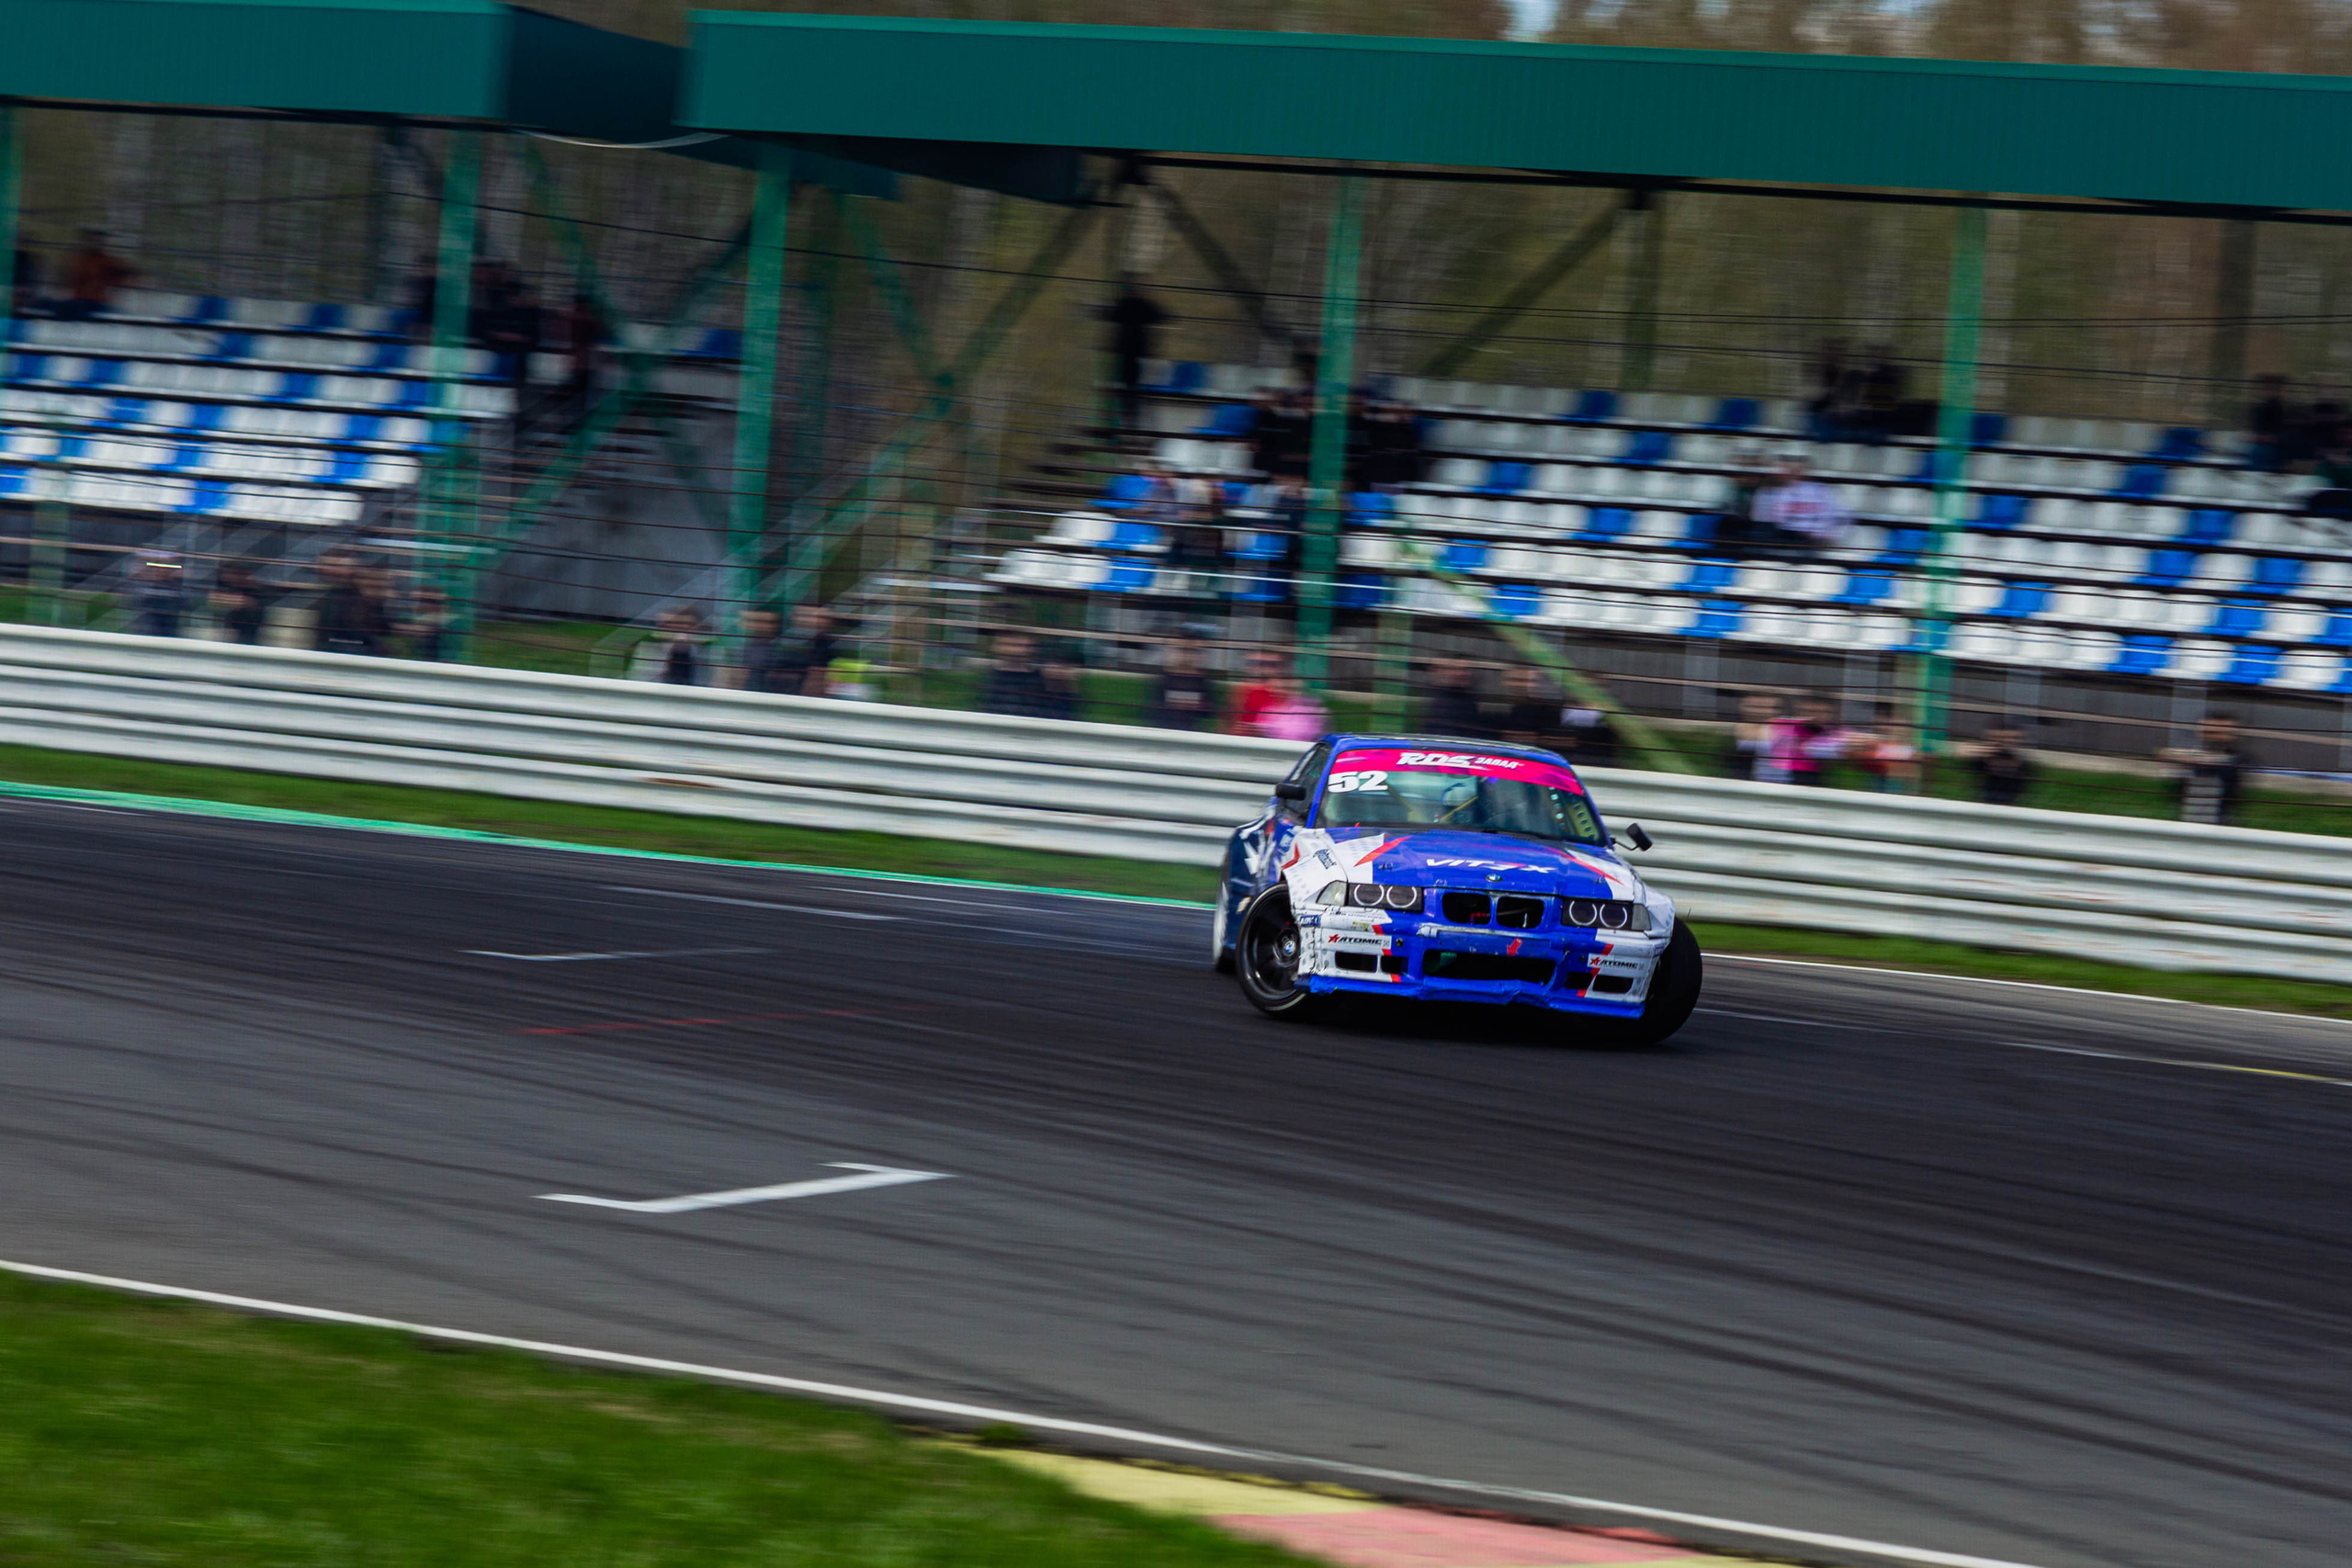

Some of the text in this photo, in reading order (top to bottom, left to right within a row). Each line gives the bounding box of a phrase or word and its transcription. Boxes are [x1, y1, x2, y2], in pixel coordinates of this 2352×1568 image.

[1396, 751, 1476, 766] RDS
[1328, 770, 1388, 793] 52
[1338, 936, 1383, 946] ATOMIC
[1600, 959, 1639, 969] ATOMIC
